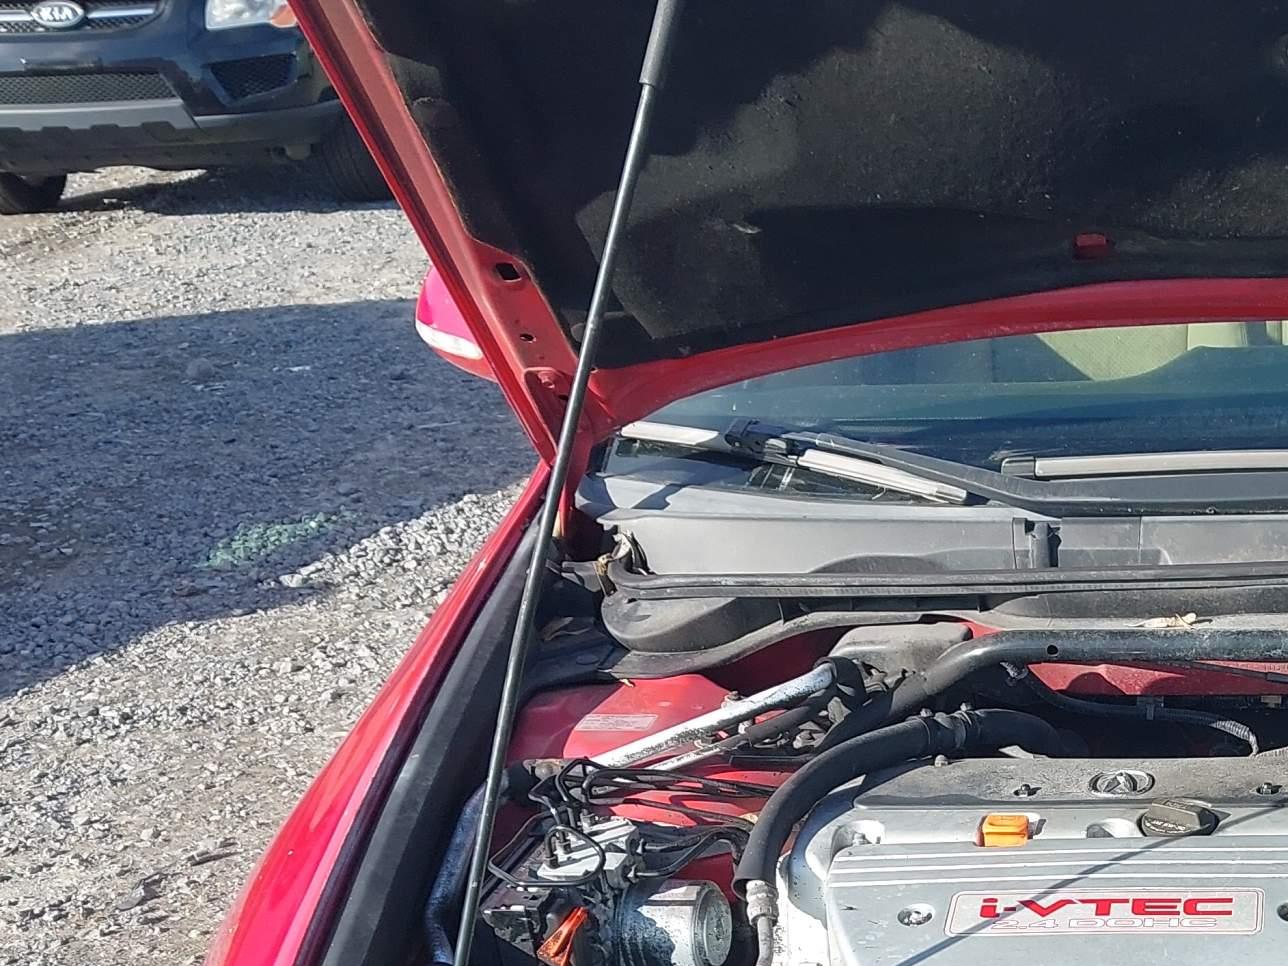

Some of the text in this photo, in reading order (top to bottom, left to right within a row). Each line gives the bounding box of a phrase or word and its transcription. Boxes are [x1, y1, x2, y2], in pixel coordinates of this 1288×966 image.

[39, 6, 74, 21] KIA
[979, 897, 1234, 919] i-VTEC
[991, 917, 1218, 930] 2.4 DOHC
